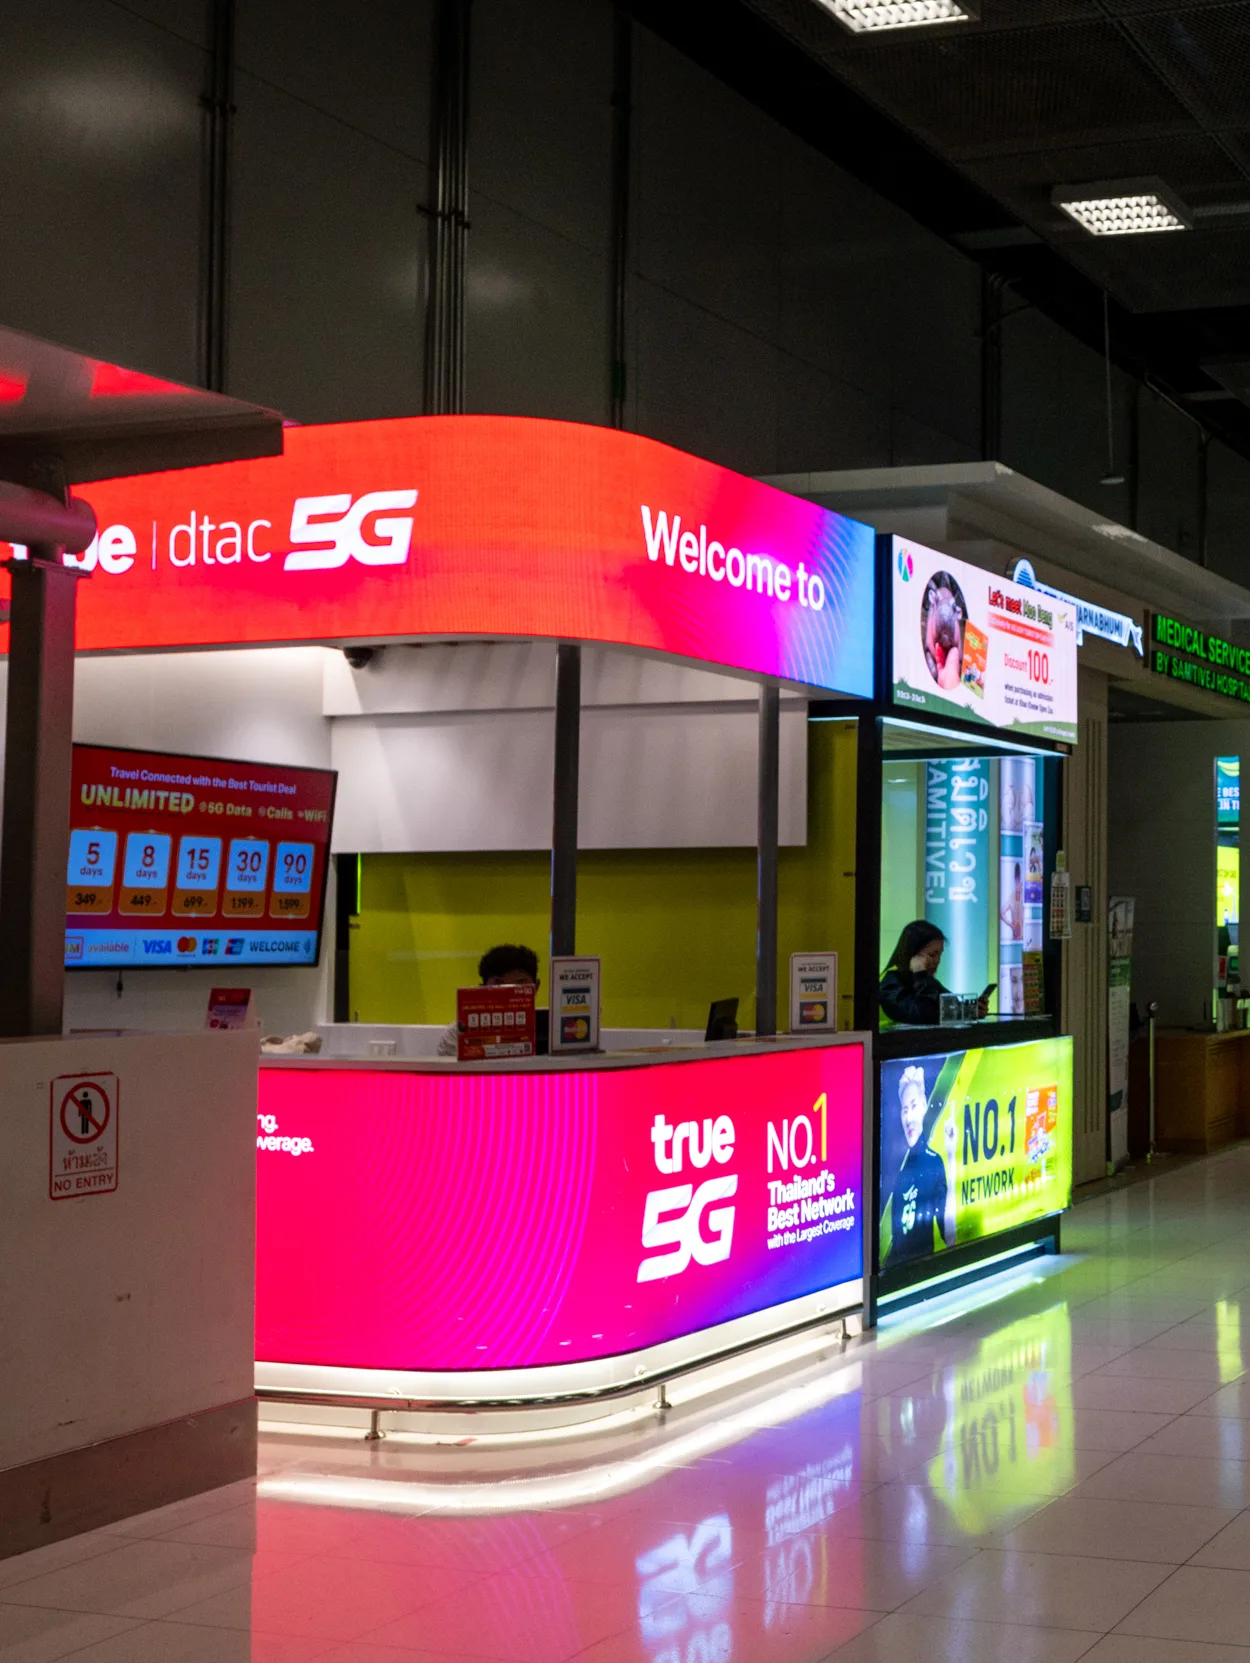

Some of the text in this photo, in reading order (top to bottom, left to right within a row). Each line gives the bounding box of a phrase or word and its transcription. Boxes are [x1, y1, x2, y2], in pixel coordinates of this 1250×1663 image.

[169, 511, 271, 567] dtac
[284, 489, 418, 571] 5G
[641, 505, 825, 611] Welcome to
[1157, 615, 1207, 658] MEDICAL
[1004, 653, 1027, 672] Discount
[1156, 651, 1169, 674] BY
[110, 766, 296, 795] Travel Connected with the Best Tourist Deal
[81, 784, 326, 822] UNLIMITED 5G Data Calls WiFi
[80, 866, 302, 885] days days days days days
[86, 843, 307, 874] 5 8 15 30 90
[87, 942, 129, 953] available
[142, 940, 172, 954] VISA
[250, 941, 300, 952] WELCOME
[566, 995, 586, 1004] VISA
[805, 984, 823, 992] VISA
[257, 1136, 314, 1156] verage.
[651, 1114, 736, 1174] true
[767, 1092, 827, 1174] NO.1
[963, 1096, 1017, 1166] NO.1
[54, 1173, 114, 1192] NO ENTRY
[767, 1170, 835, 1206] Thailand's
[961, 1167, 1015, 1206] NETWORK
[768, 1188, 855, 1232] Best Network
[637, 1174, 738, 1284] 5G
[767, 1215, 855, 1250] with the Largest Coverage
